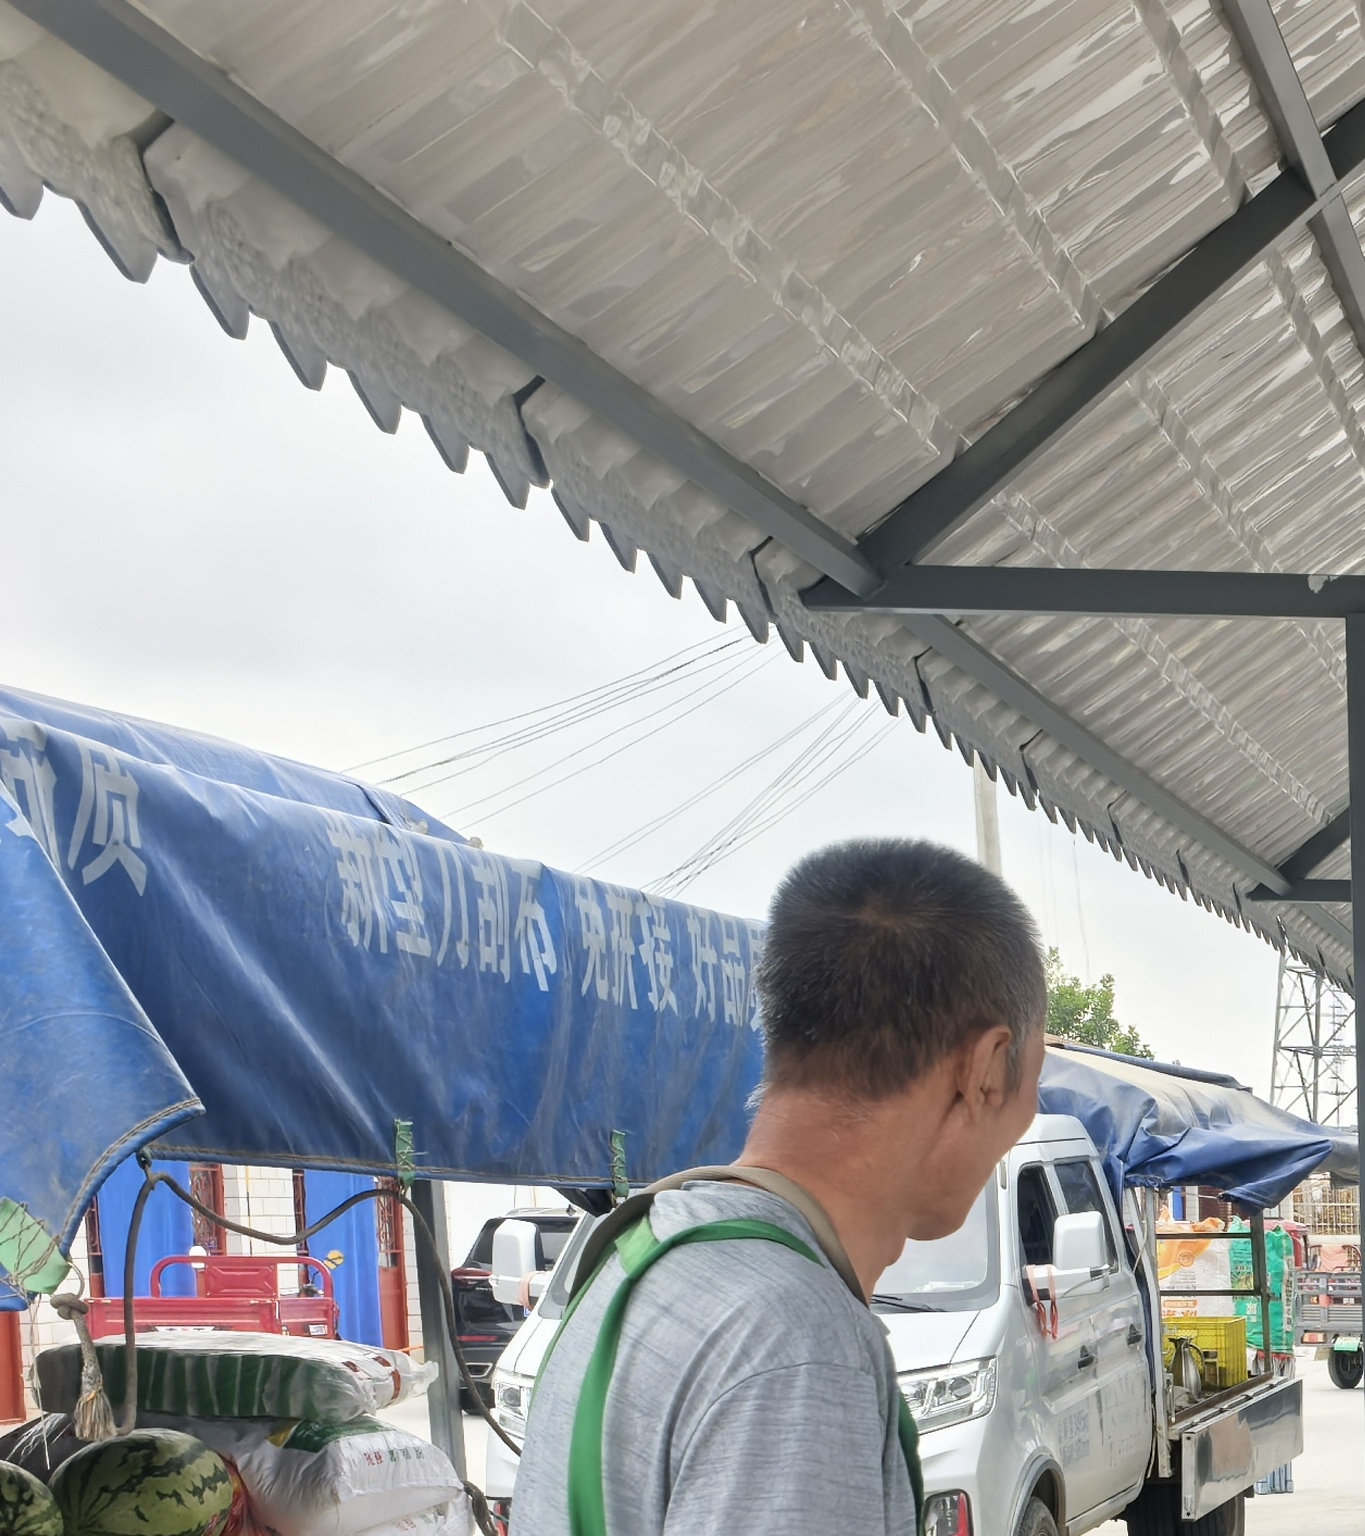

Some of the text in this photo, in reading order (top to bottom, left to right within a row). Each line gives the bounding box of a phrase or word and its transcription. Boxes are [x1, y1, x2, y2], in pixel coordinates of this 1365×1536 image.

[327, 818, 557, 992] 新型刀刮布
[575, 872, 678, 1016] 免拼接
